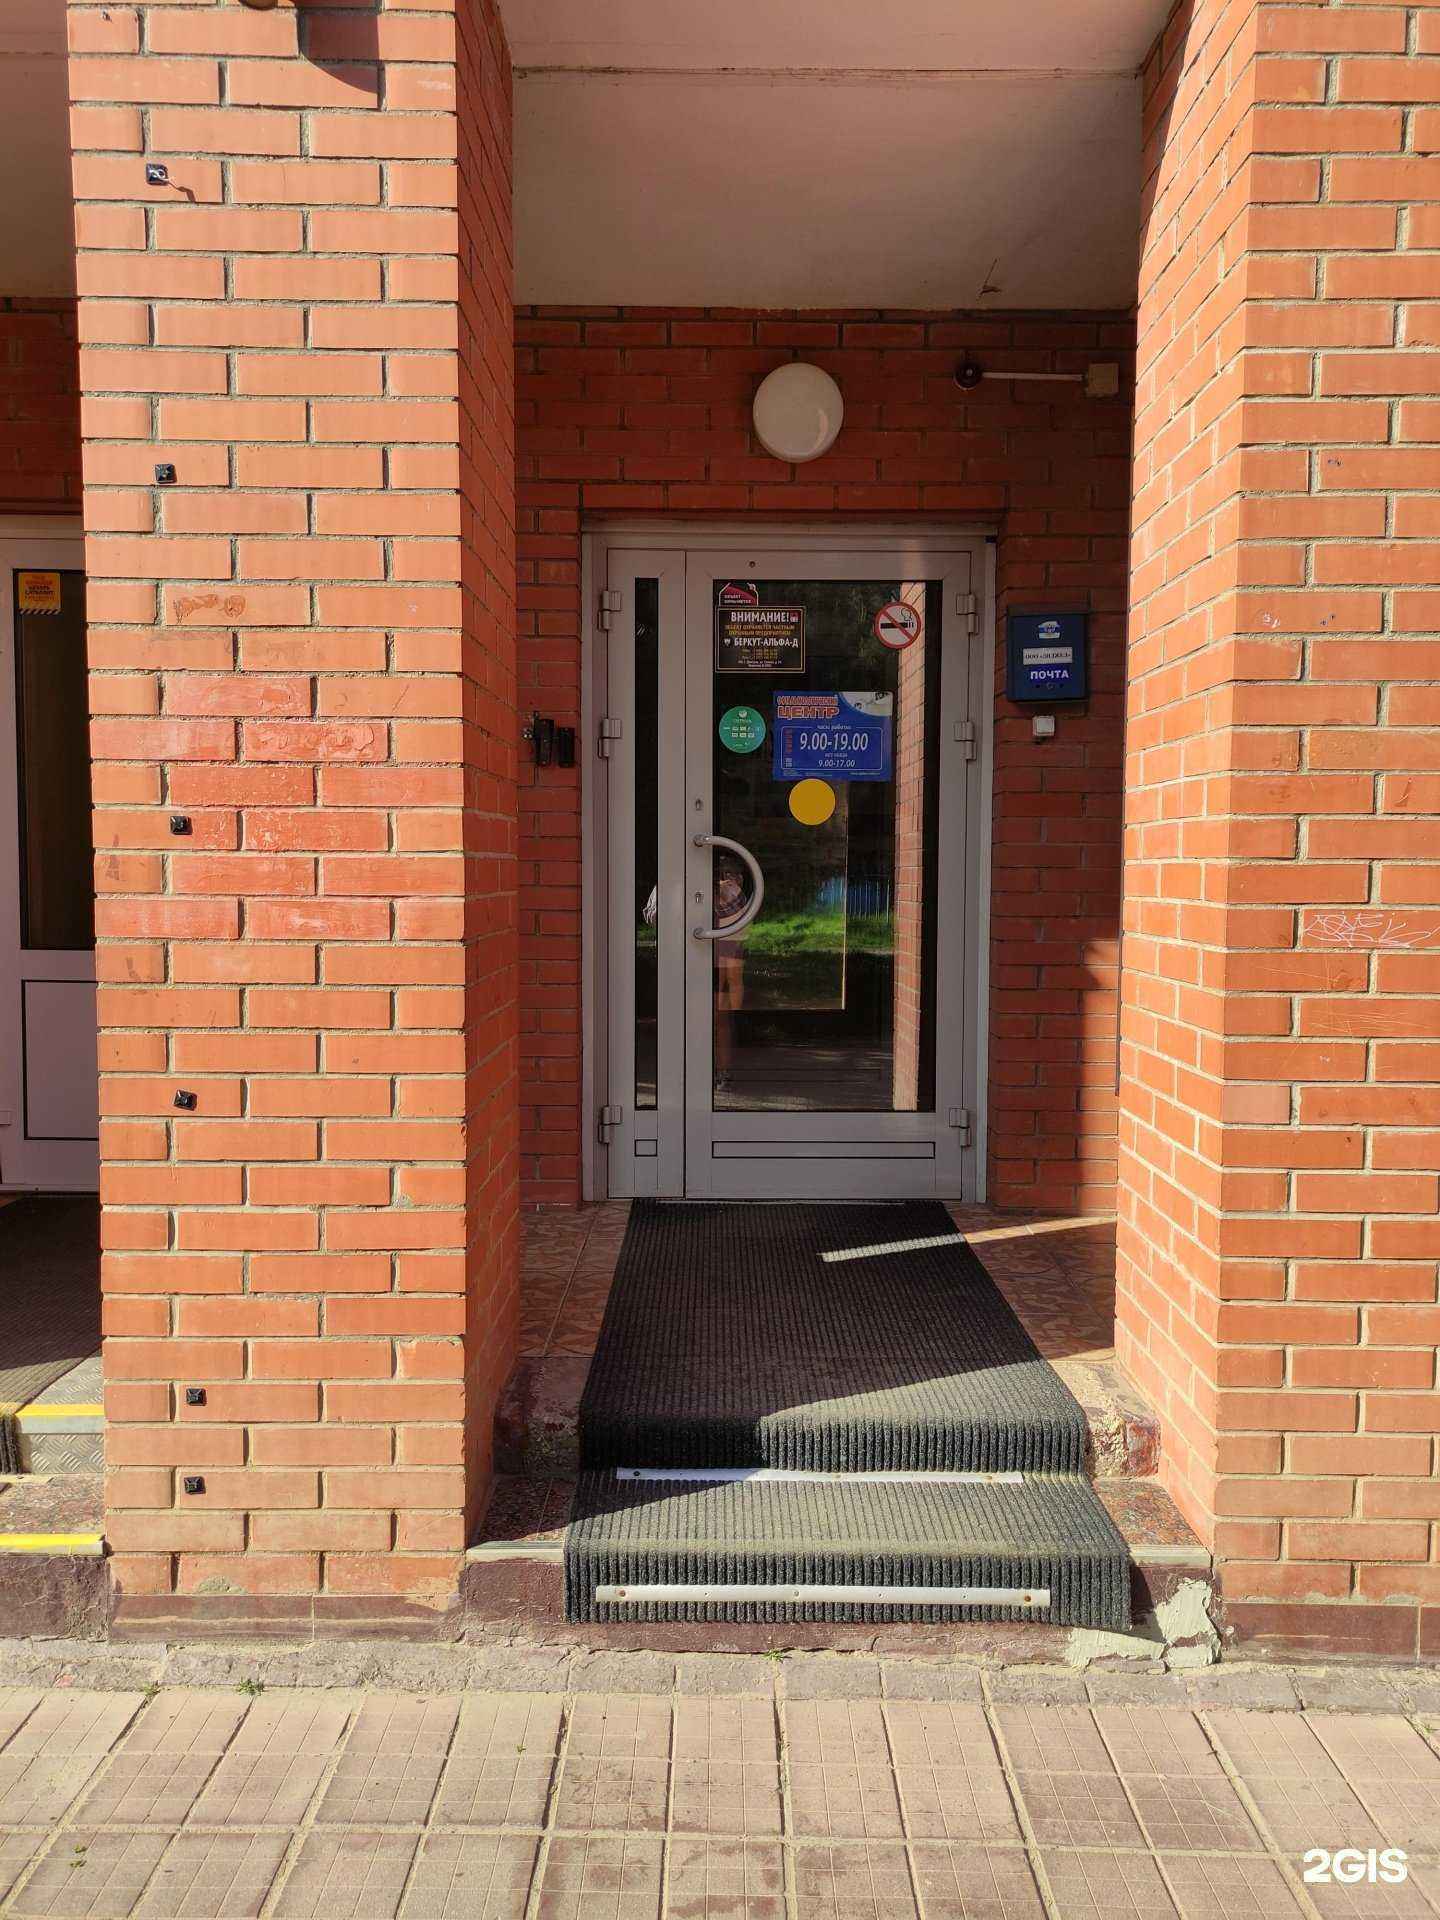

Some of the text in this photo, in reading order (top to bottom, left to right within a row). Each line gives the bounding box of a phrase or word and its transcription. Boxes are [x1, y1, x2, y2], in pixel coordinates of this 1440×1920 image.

[730, 611, 790, 622] ВНИМАНИЕ!
[734, 637, 799, 648] БЕРКУТ-АЛЬФА-Д
[1030, 669, 1069, 680] ПОЧТА
[776, 705, 840, 720] ЦЕНТР
[799, 732, 869, 751] 9.00-19.00
